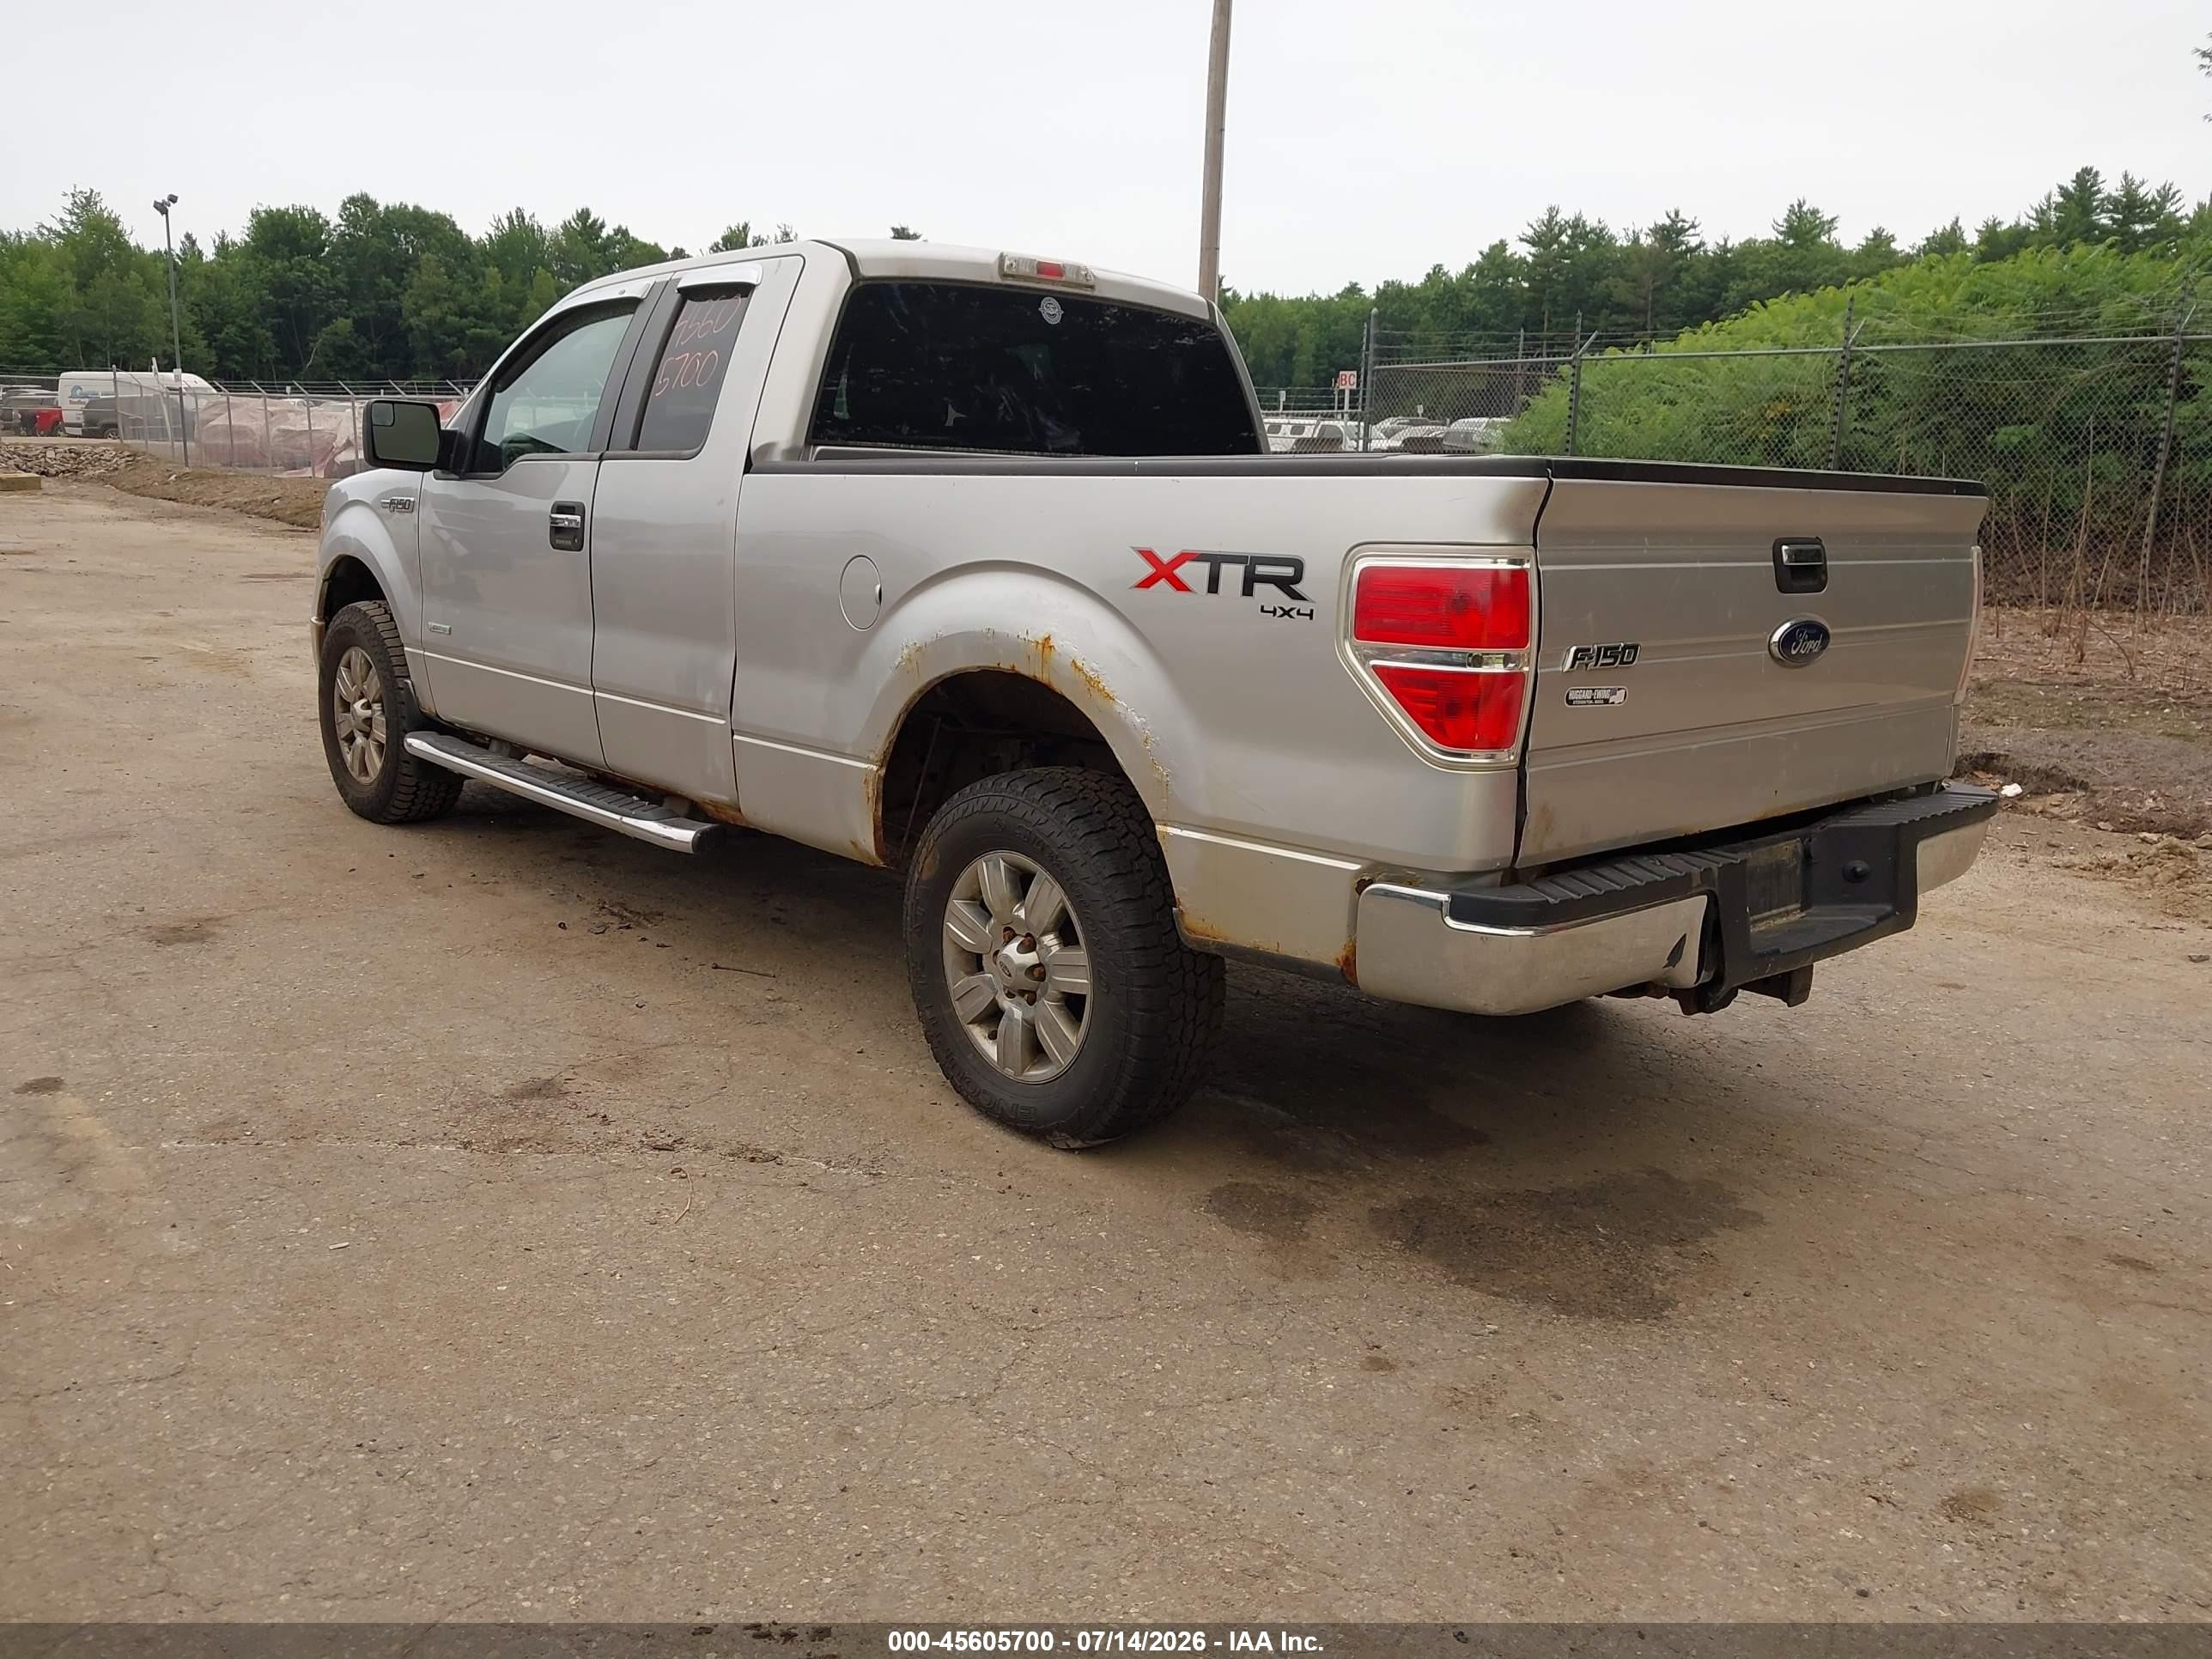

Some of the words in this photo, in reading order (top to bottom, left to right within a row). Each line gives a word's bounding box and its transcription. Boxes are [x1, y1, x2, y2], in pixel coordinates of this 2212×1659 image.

[655, 349, 719, 396] 5700
[1340, 373, 1356, 386] BC
[1129, 547, 1316, 603] XTR
[1791, 629, 1823, 654] Ford
